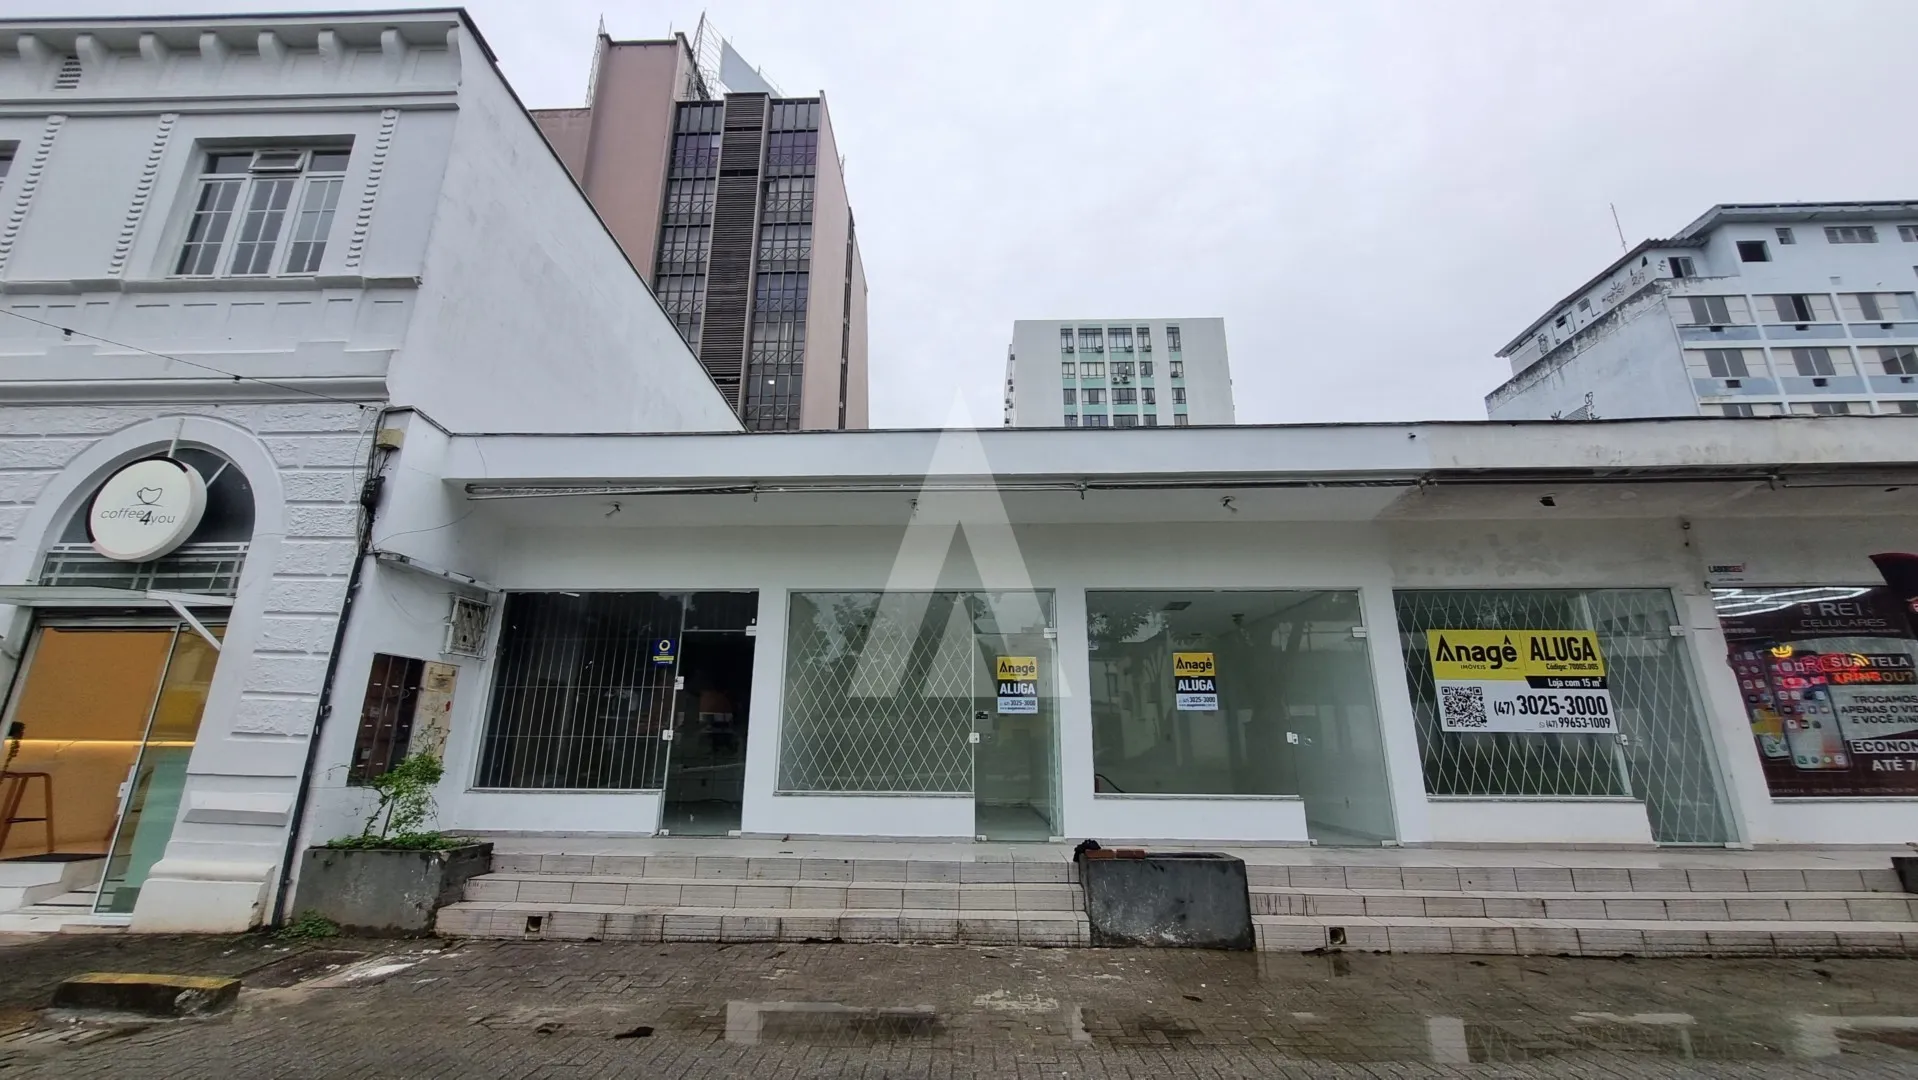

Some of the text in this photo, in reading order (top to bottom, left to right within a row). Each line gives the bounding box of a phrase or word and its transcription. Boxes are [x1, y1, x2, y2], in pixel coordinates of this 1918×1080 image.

[1818, 602, 1863, 617] REI
[1800, 618, 1888, 628] CELULARES
[1435, 634, 1518, 670] Anagê
[1530, 636, 1598, 662] ALUGA
[1175, 656, 1213, 673] Anagê
[1870, 656, 1909, 667] TELA
[999, 660, 1036, 676] Anagê
[999, 682, 1036, 695] ALUGA
[1177, 679, 1215, 691] ALUGA
[1547, 677, 1564, 689] Loja
[1581, 678, 1591, 687] 15
[1493, 694, 1609, 716] (47) 3025-3000
[1852, 695, 1918, 703] TROCAMOS
[1841, 705, 1888, 714] APENAS
[1889, 705, 1899, 714] O
[1558, 717, 1611, 729] 99653-1009
[1852, 715, 1860, 724] E
[1860, 714, 1895, 724] VOCÊ
[1872, 756, 1918, 771] ATÉ 7
